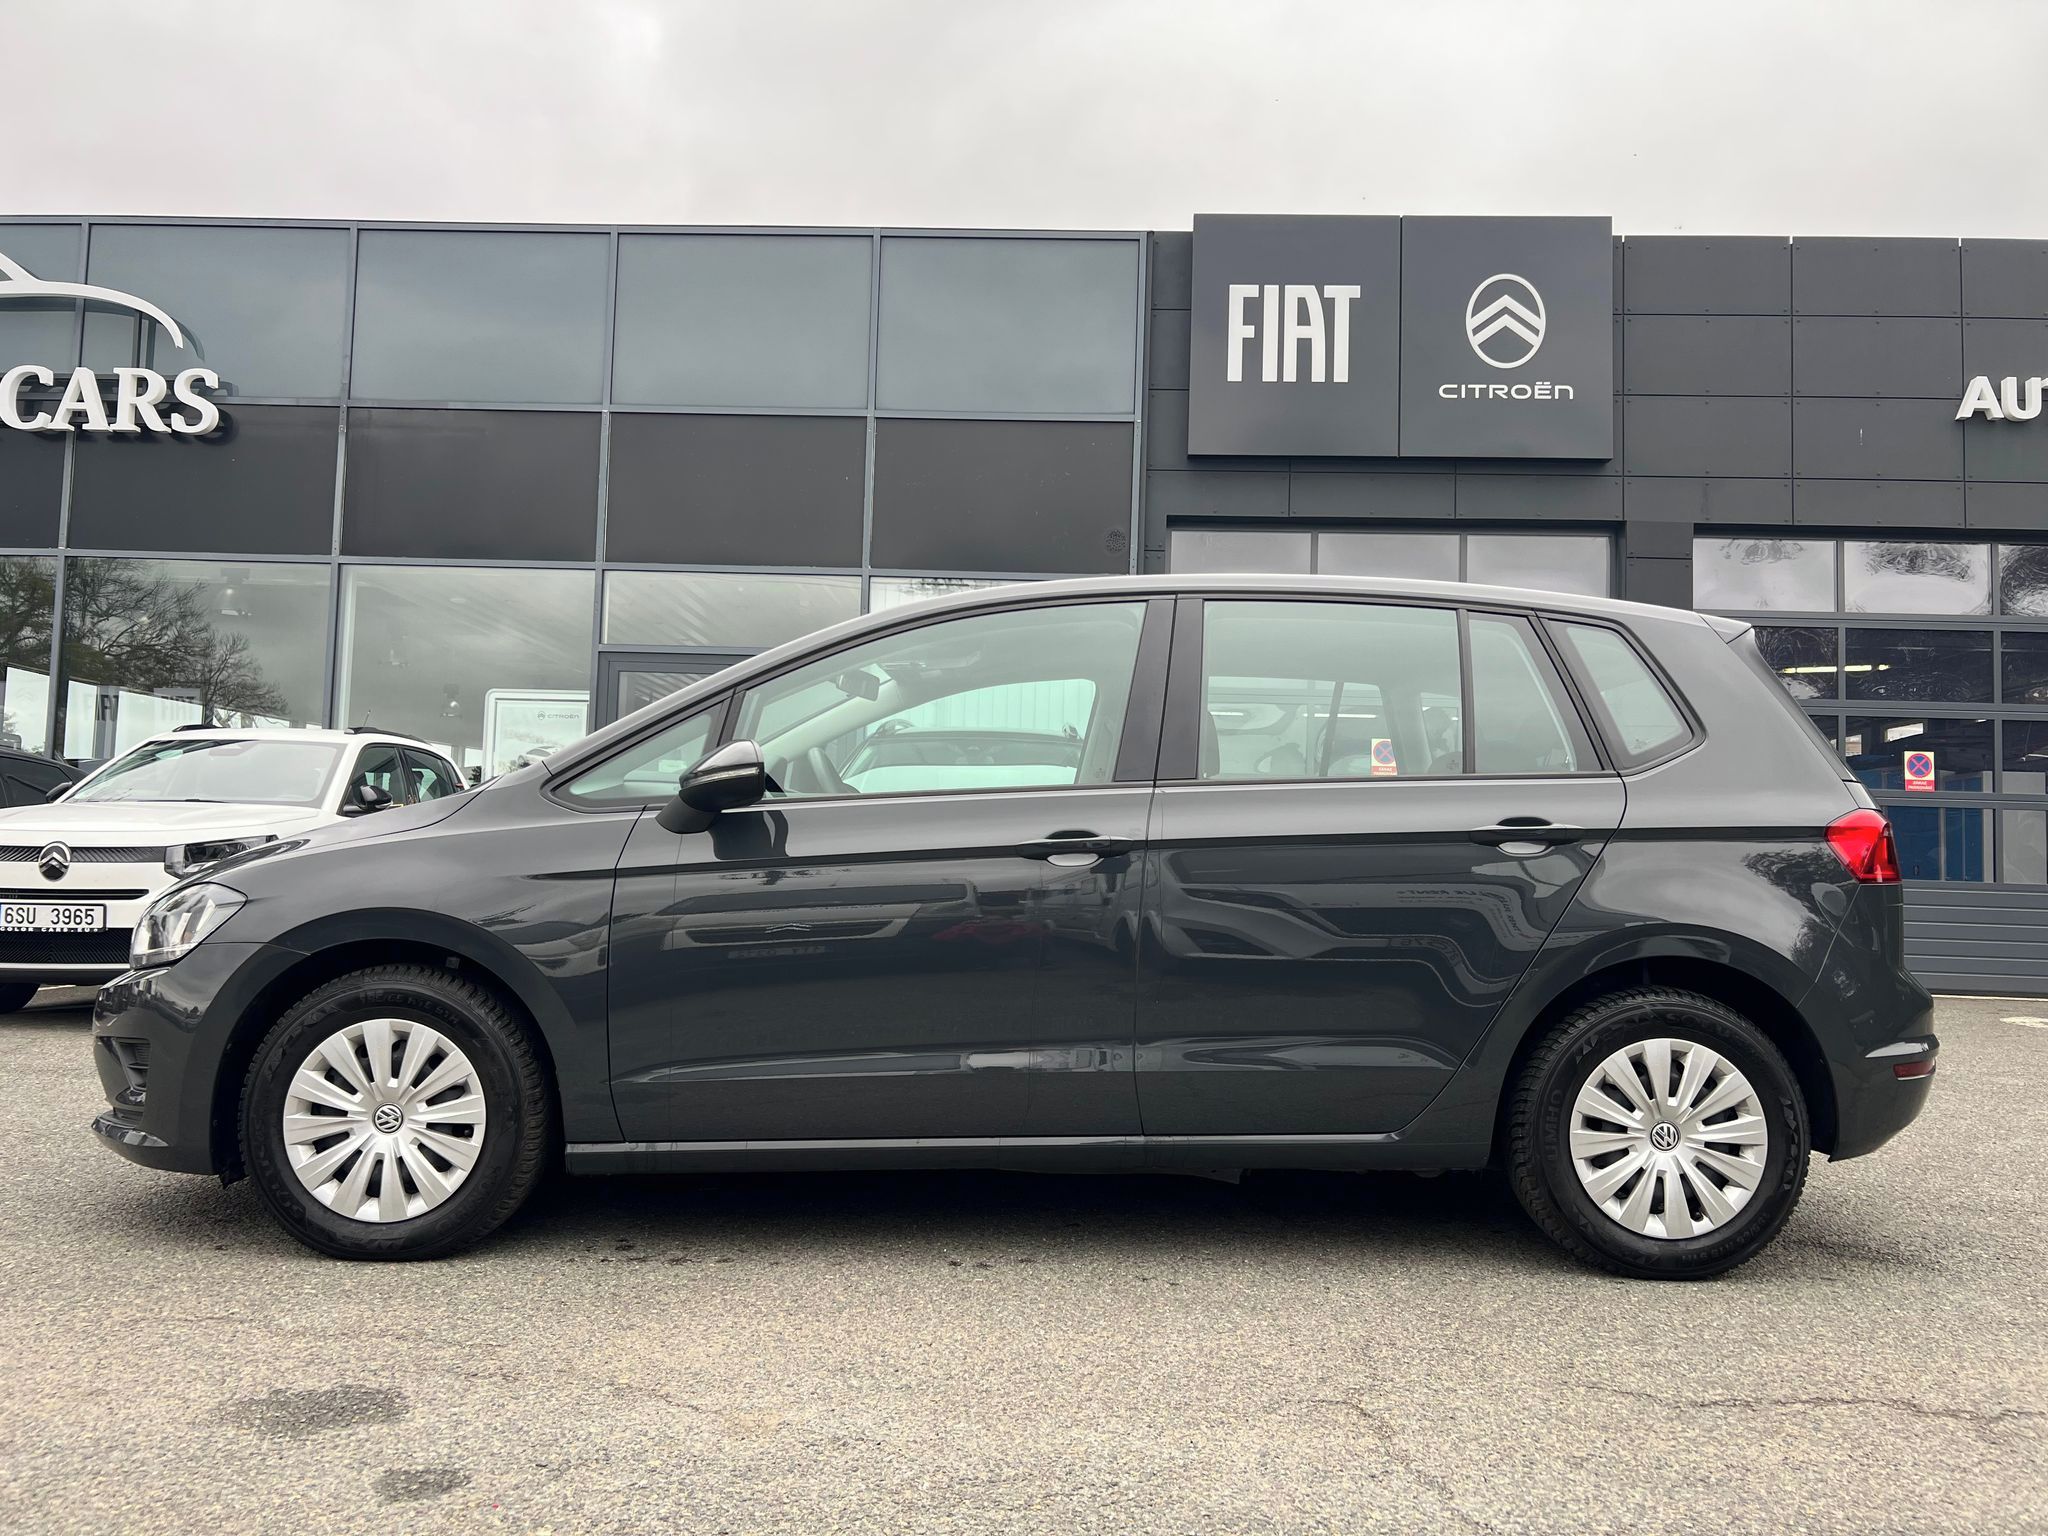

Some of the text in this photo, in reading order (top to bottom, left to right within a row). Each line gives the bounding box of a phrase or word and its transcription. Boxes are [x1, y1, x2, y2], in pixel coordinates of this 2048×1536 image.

[1227, 284, 1361, 383] FIAT
[0, 364, 220, 435] CARS
[1438, 381, 1575, 400] CITROËN
[1954, 375, 2048, 421] AU
[4, 907, 95, 926] 6SU 3965
